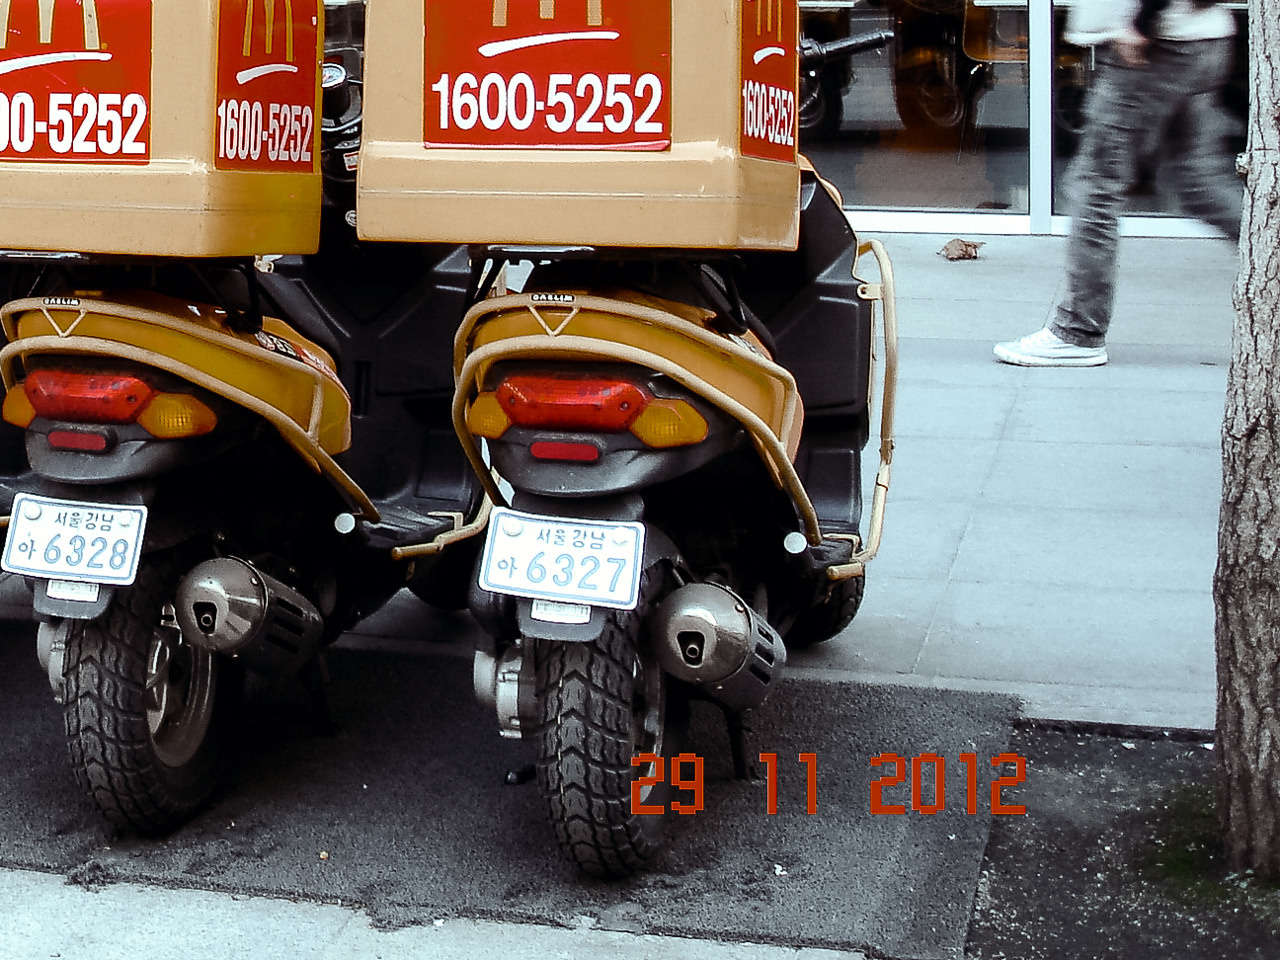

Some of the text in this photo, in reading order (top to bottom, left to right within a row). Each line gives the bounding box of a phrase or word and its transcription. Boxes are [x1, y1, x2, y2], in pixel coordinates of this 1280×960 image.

[431, 72, 664, 133] 1600-5252
[218, 99, 313, 162] 1600-5252
[18, 533, 129, 570] 아 6328
[497, 551, 627, 592] 아 6327
